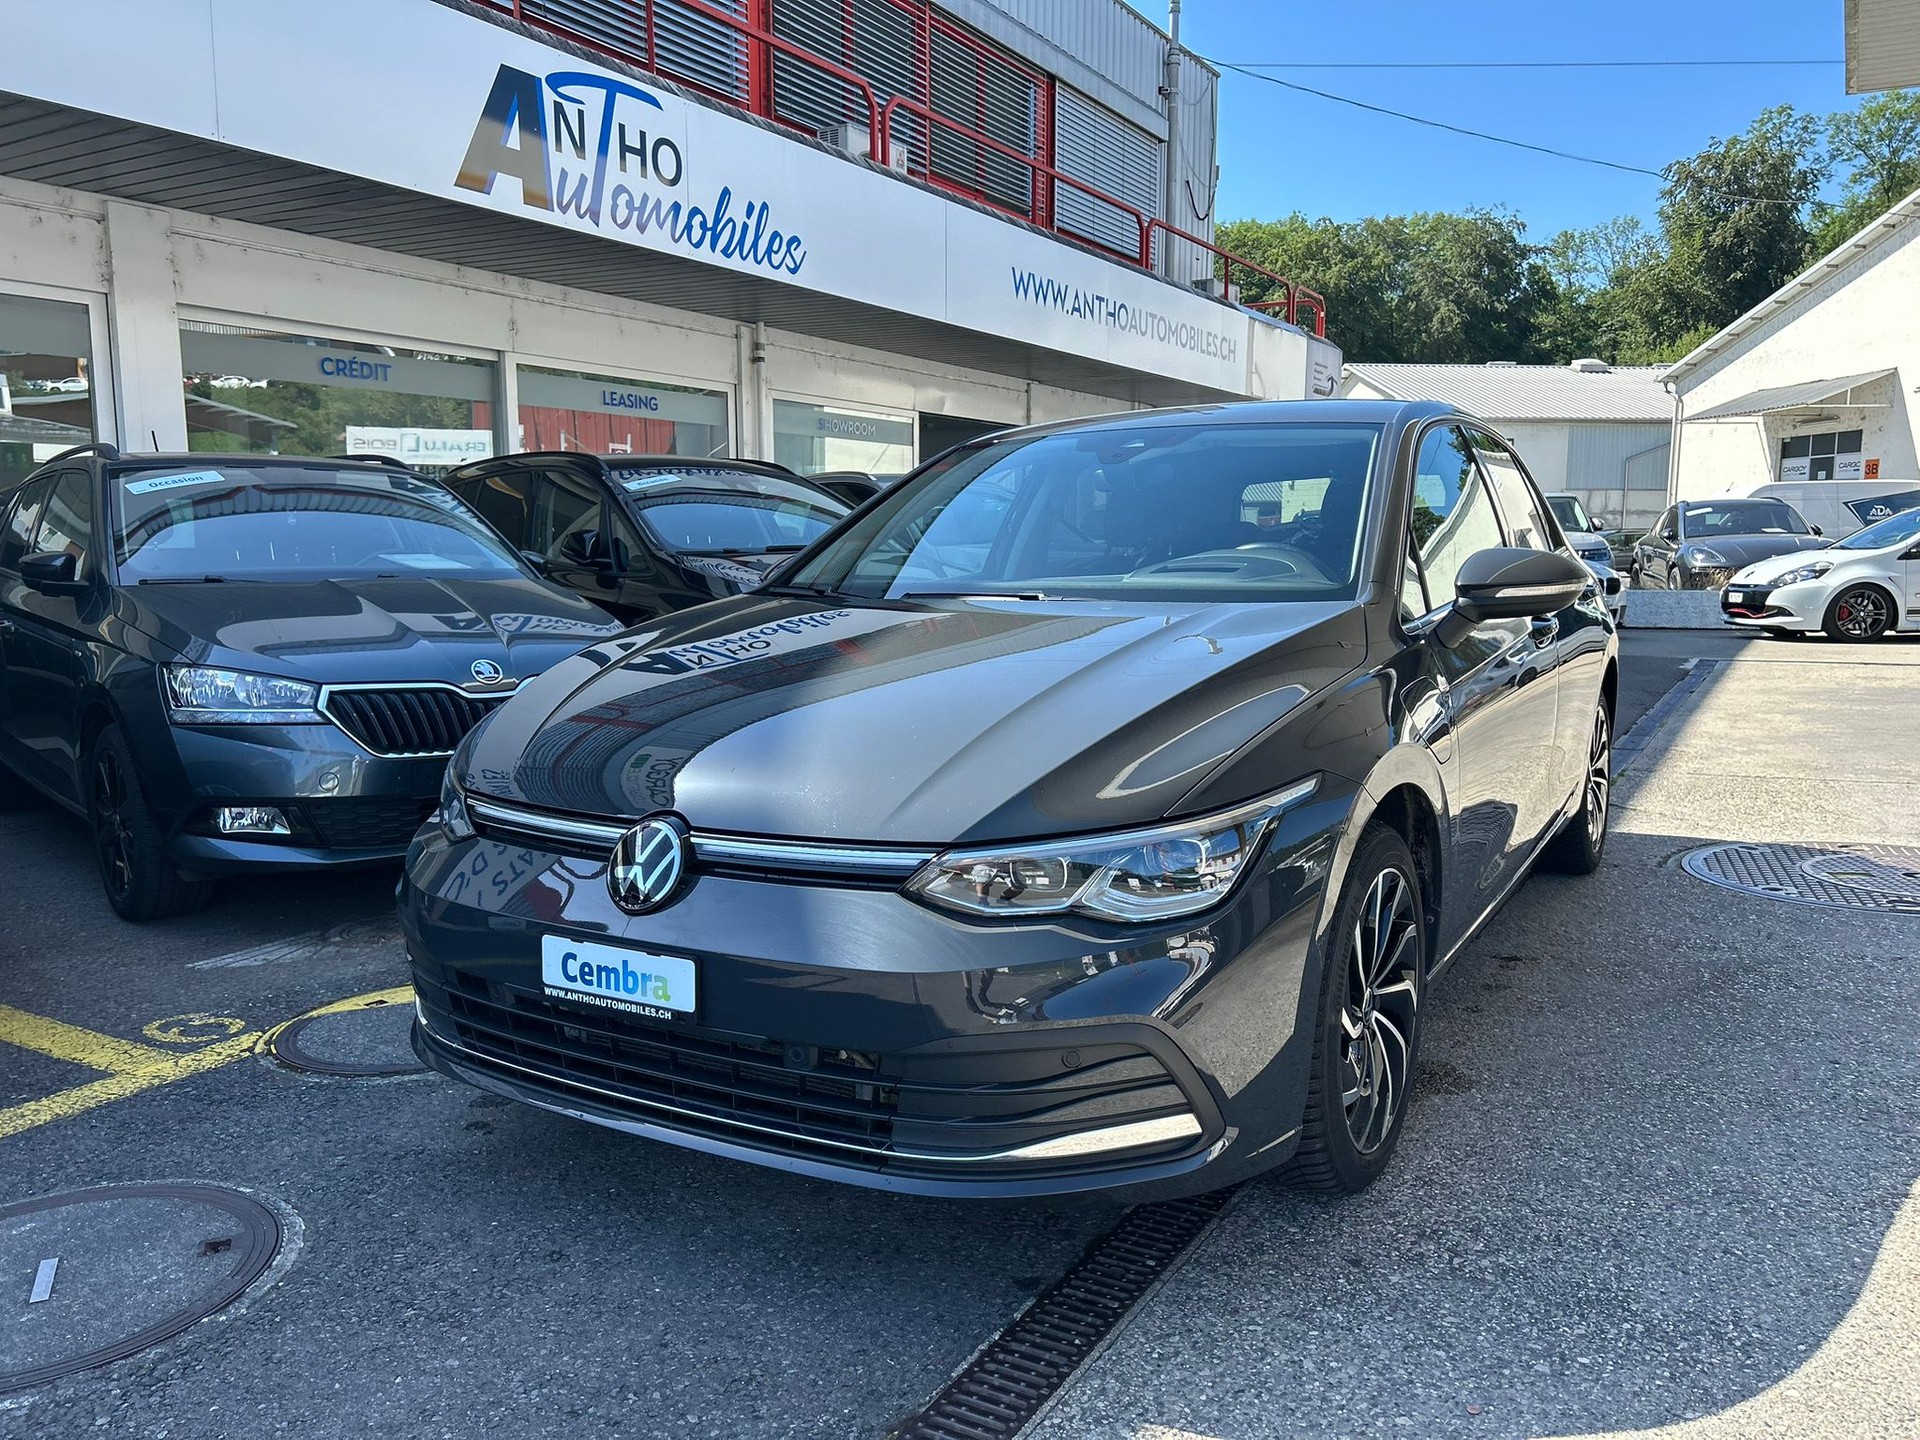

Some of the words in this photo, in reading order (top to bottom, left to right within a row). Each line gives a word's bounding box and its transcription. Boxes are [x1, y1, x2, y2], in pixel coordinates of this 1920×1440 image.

[454, 63, 682, 214] ANTHO
[1012, 267, 1236, 363] WWW.ANTHOAUTOMOBILES.CH
[321, 356, 392, 382] CRÉDIT
[602, 390, 658, 411] LEASING
[817, 417, 876, 436] SHOWROOM
[1865, 463, 1878, 474] 3B
[148, 475, 203, 488] Occasion
[1869, 505, 1893, 516] ADA
[561, 952, 671, 1002] Cembra
[544, 987, 671, 1020] WWW.ANTHOAUTOMOBILES.CH
